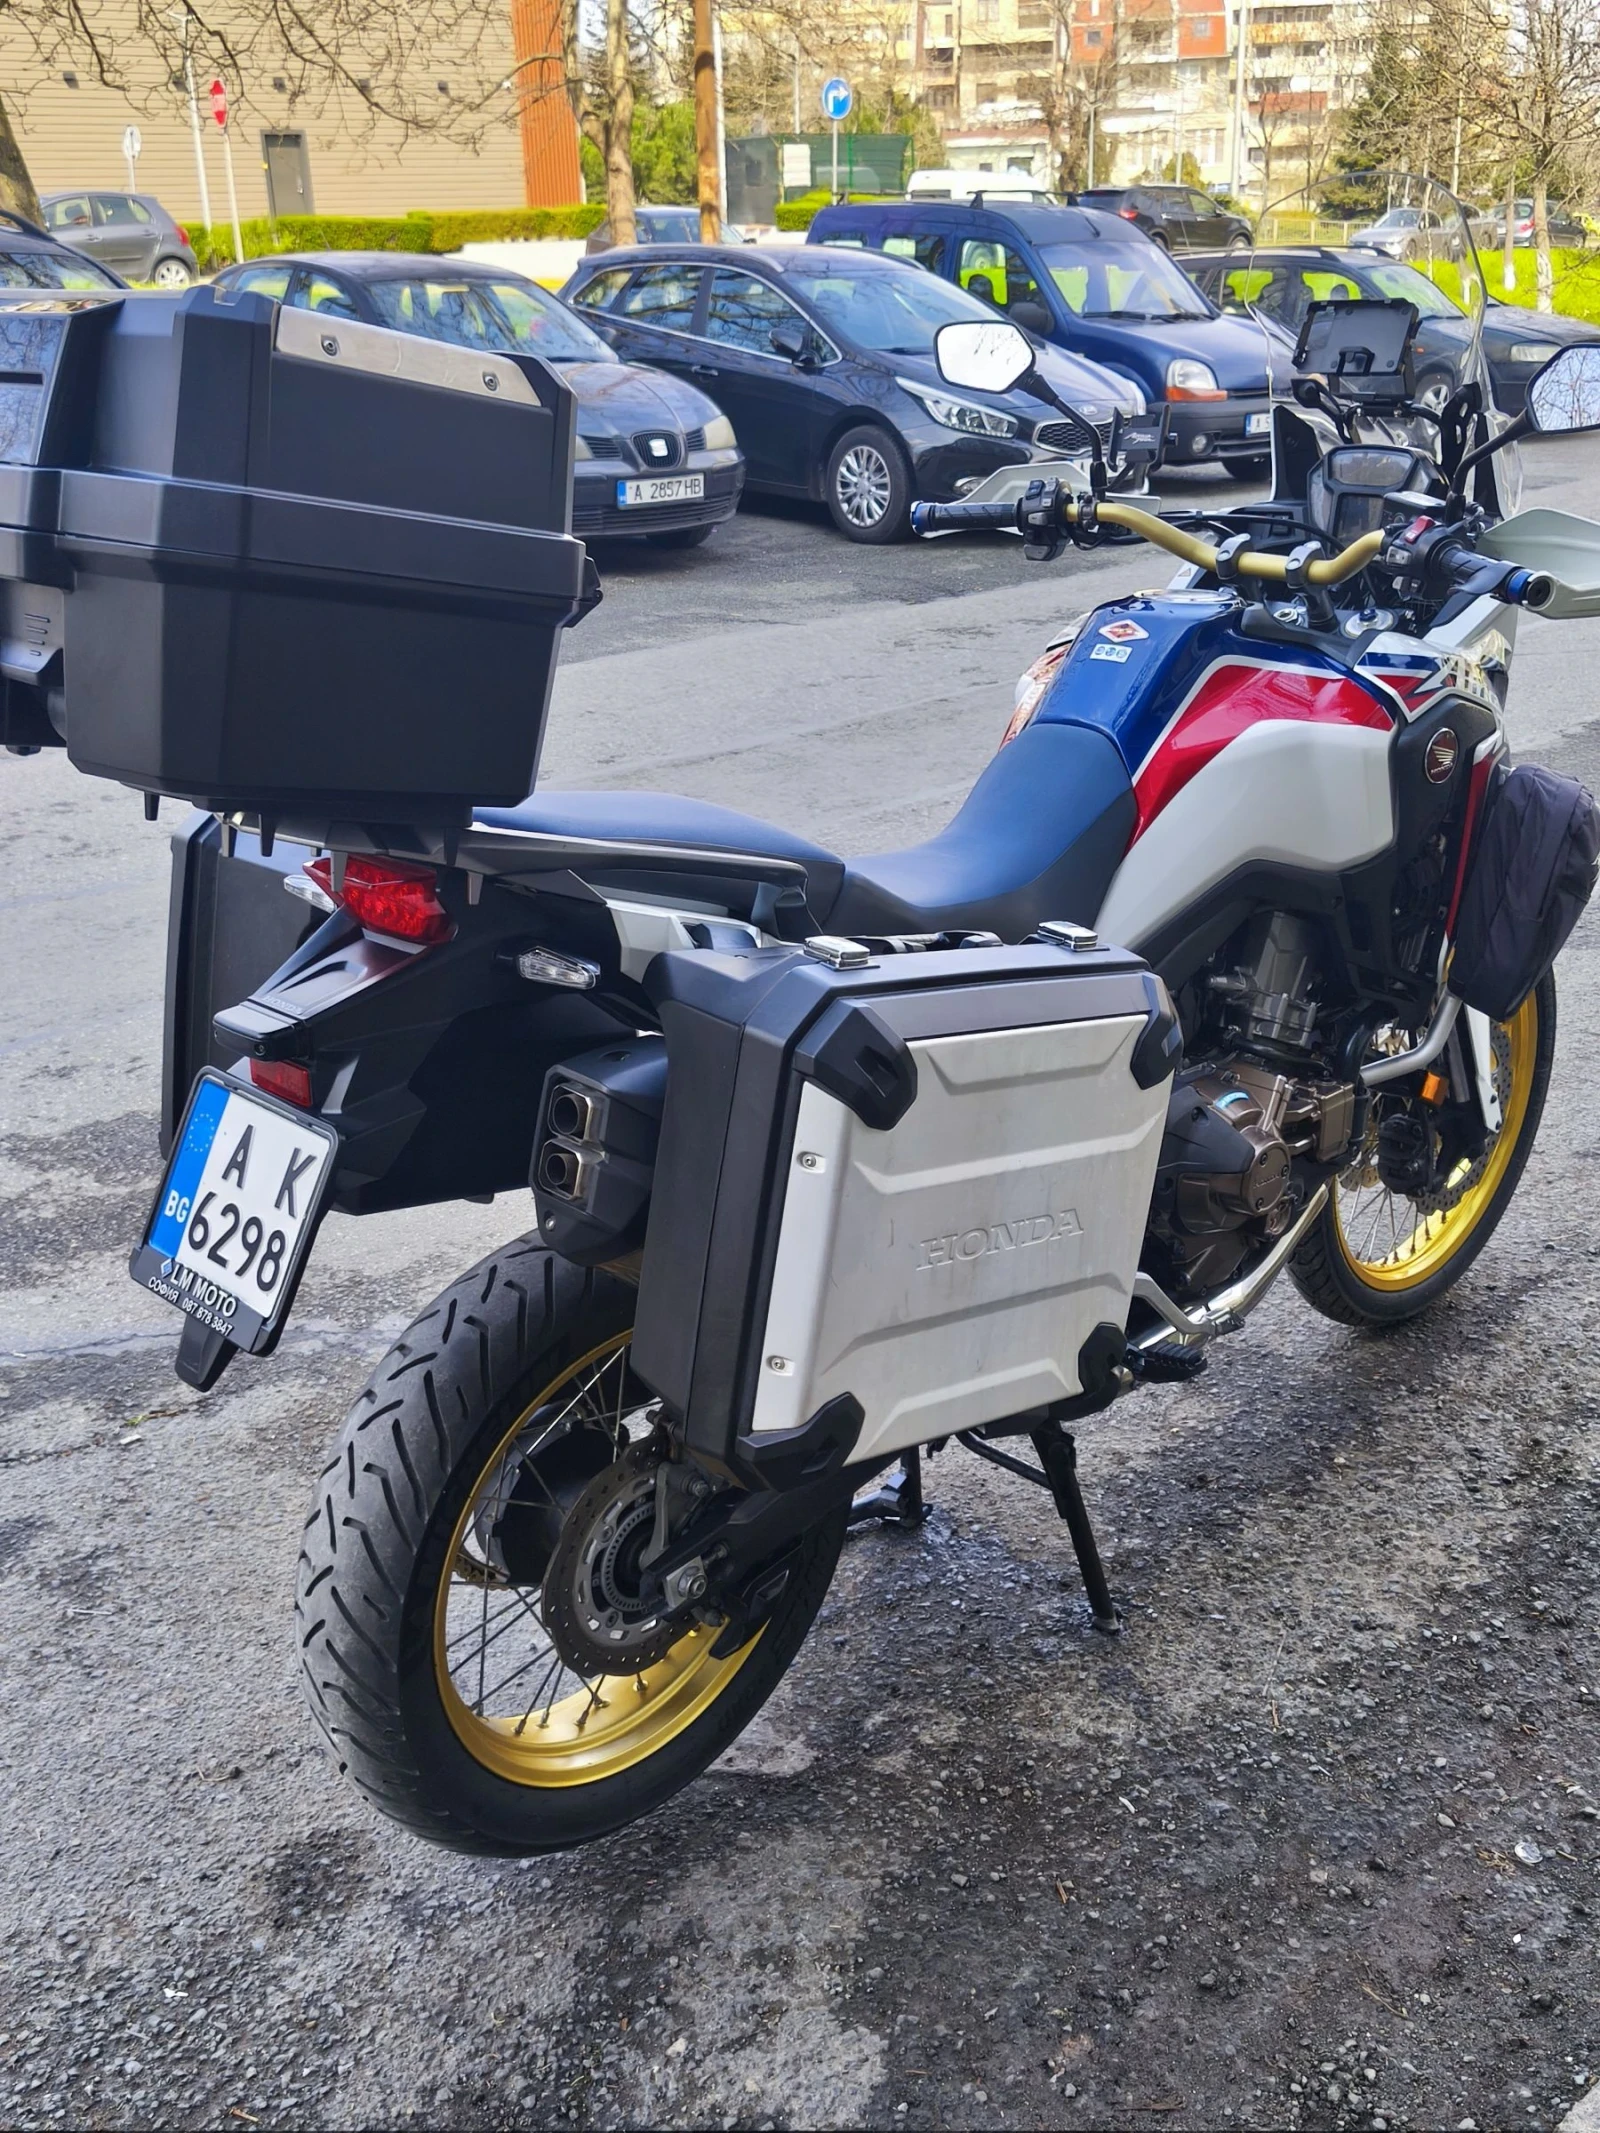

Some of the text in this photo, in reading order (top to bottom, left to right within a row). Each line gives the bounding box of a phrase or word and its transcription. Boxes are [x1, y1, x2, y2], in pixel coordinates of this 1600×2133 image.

[634, 484, 643, 501] A
[221, 1124, 317, 1219] A K
[164, 1189, 190, 1223] BG
[188, 1191, 286, 1292] 6298
[916, 1208, 1084, 1271] HONDA
[170, 1263, 237, 1317] LM MOTO
[182, 1297, 199, 1314] 087
[196, 1307, 213, 1324] 878
